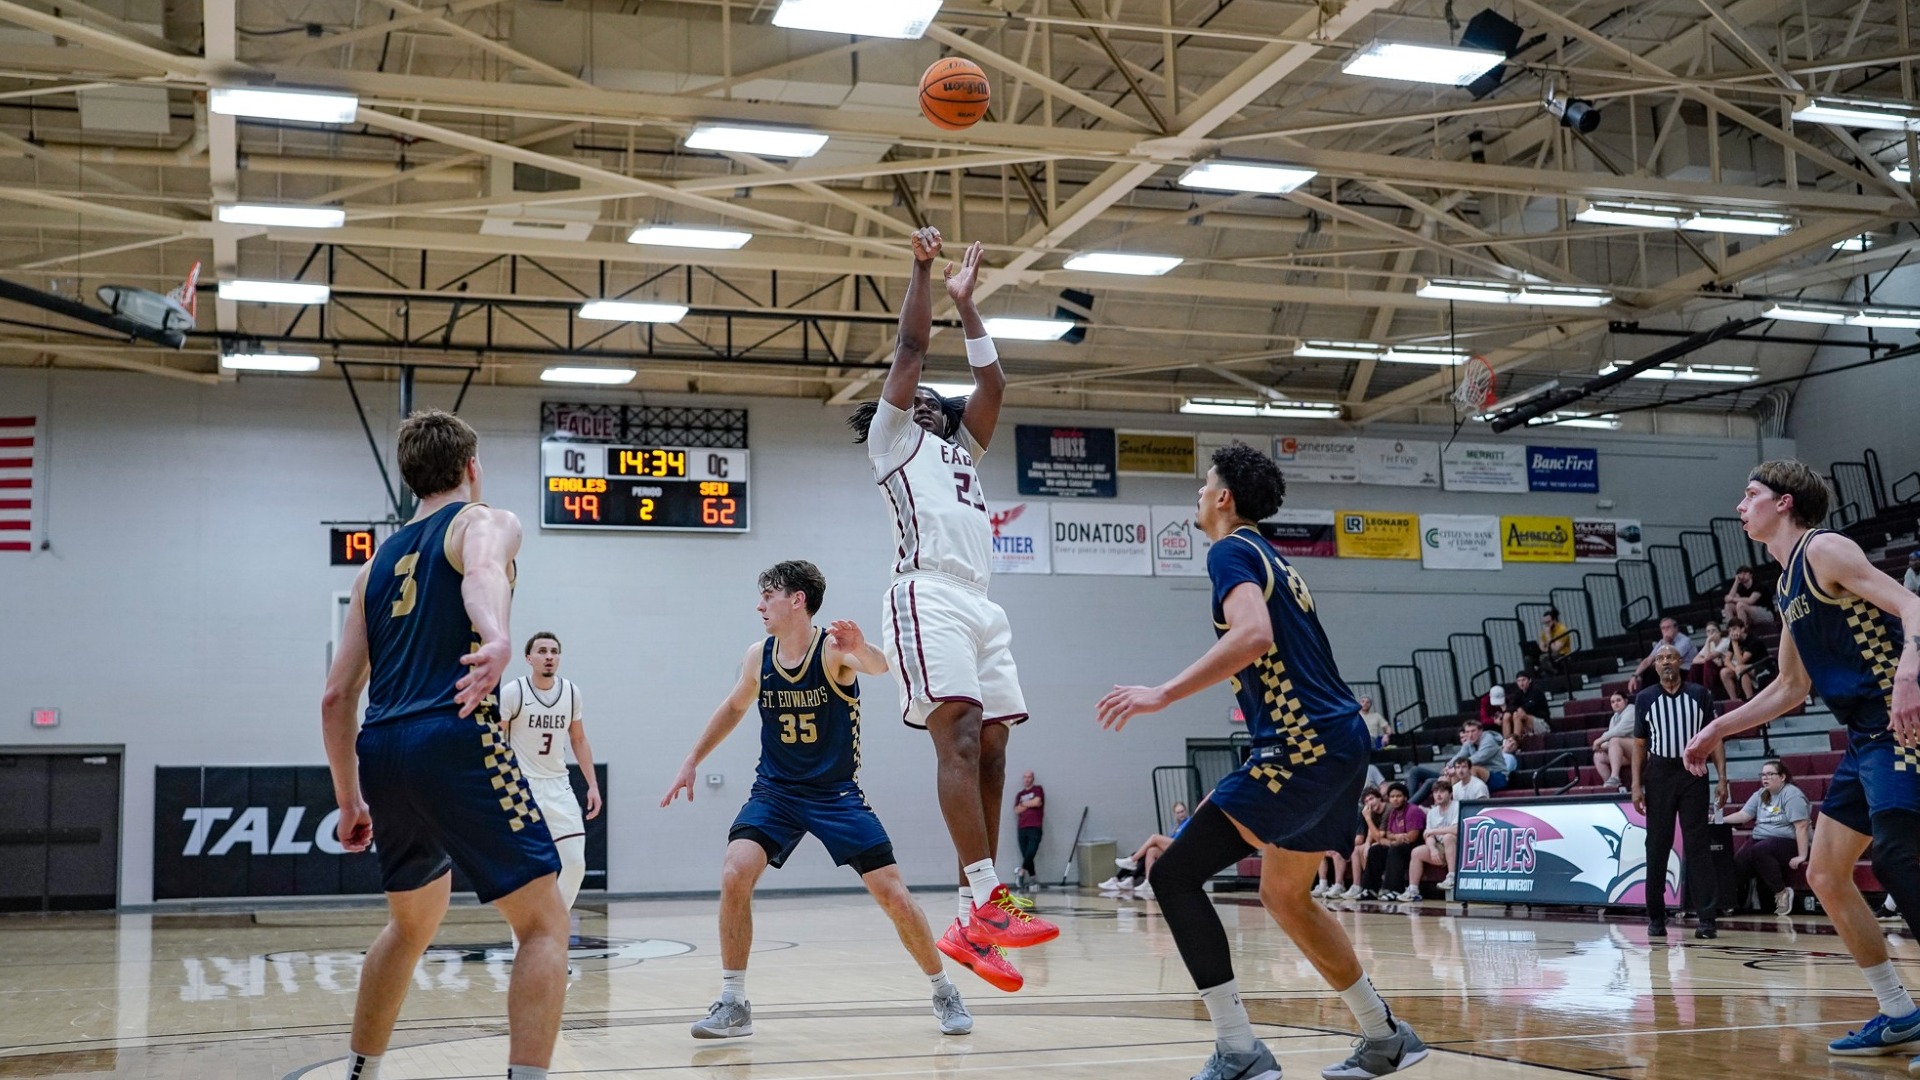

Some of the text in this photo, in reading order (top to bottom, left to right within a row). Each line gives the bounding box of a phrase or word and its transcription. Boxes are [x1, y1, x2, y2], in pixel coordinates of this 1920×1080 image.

[943, 81, 987, 95] Wilson
[1050, 437, 1086, 457] HOUSE
[1119, 440, 1193, 455] Southwestern
[1283, 439, 1355, 453] Cornerstone
[1466, 450, 1505, 459] MERRITT
[564, 450, 585, 473] OC
[620, 450, 685, 477] 14:34
[708, 454, 728, 478] OC
[549, 478, 607, 493] EAGLES
[699, 482, 729, 496] SEU
[563, 495, 599, 520] 49
[639, 499, 654, 521] 2
[702, 498, 736, 525] 62
[1055, 522, 1134, 543] DONATOS
[1366, 518, 1409, 527] LEONARD
[1574, 523, 1615, 531] VILLAGE
[346, 532, 371, 560] 19
[1162, 538, 1187, 548] RED
[391, 551, 420, 618] 3
[762, 685, 828, 708] ST. EDWARD'S
[528, 714, 566, 729] EAGLES
[778, 713, 818, 744] 35
[538, 733, 553, 755] 3
[182, 806, 377, 856] TALO
[1459, 816, 1538, 875] EAGLES
[1482, 878, 1506, 891] CHRISTIAN
[1506, 879, 1535, 892] UNIVERSITY
